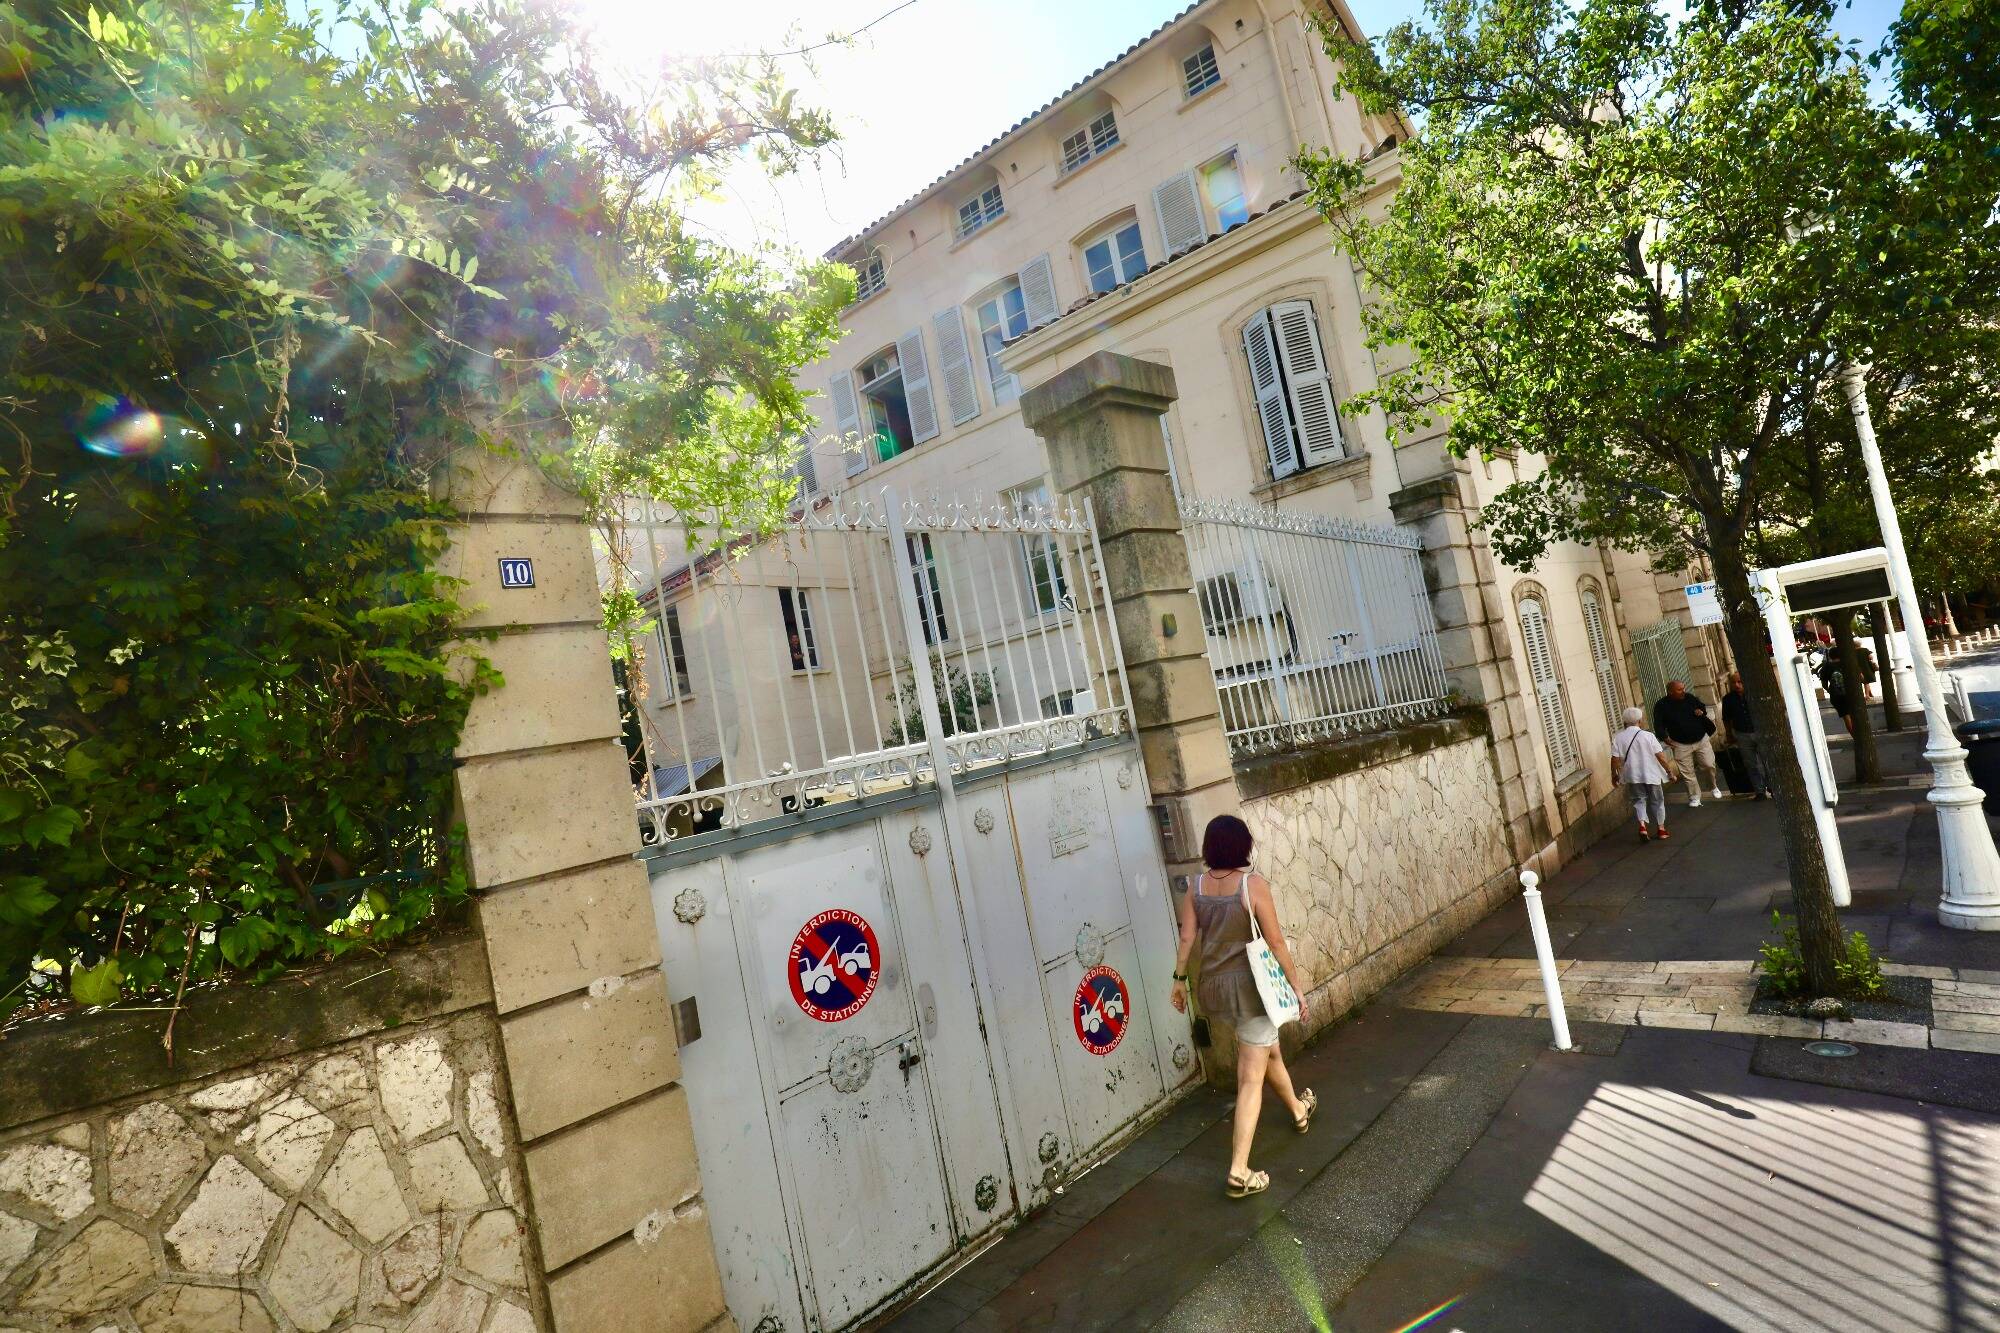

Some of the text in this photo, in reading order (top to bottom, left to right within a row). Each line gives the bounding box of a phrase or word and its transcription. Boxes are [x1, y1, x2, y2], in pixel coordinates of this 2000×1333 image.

[505, 563, 529, 584] 10
[1690, 586, 1699, 594] 40
[790, 910, 868, 960] INTERDICTION
[801, 970, 879, 1021] DE STATIONNER
[1074, 967, 1121, 1006] INTERDICTION
[1081, 1014, 1129, 1055] DE STATIONNER
